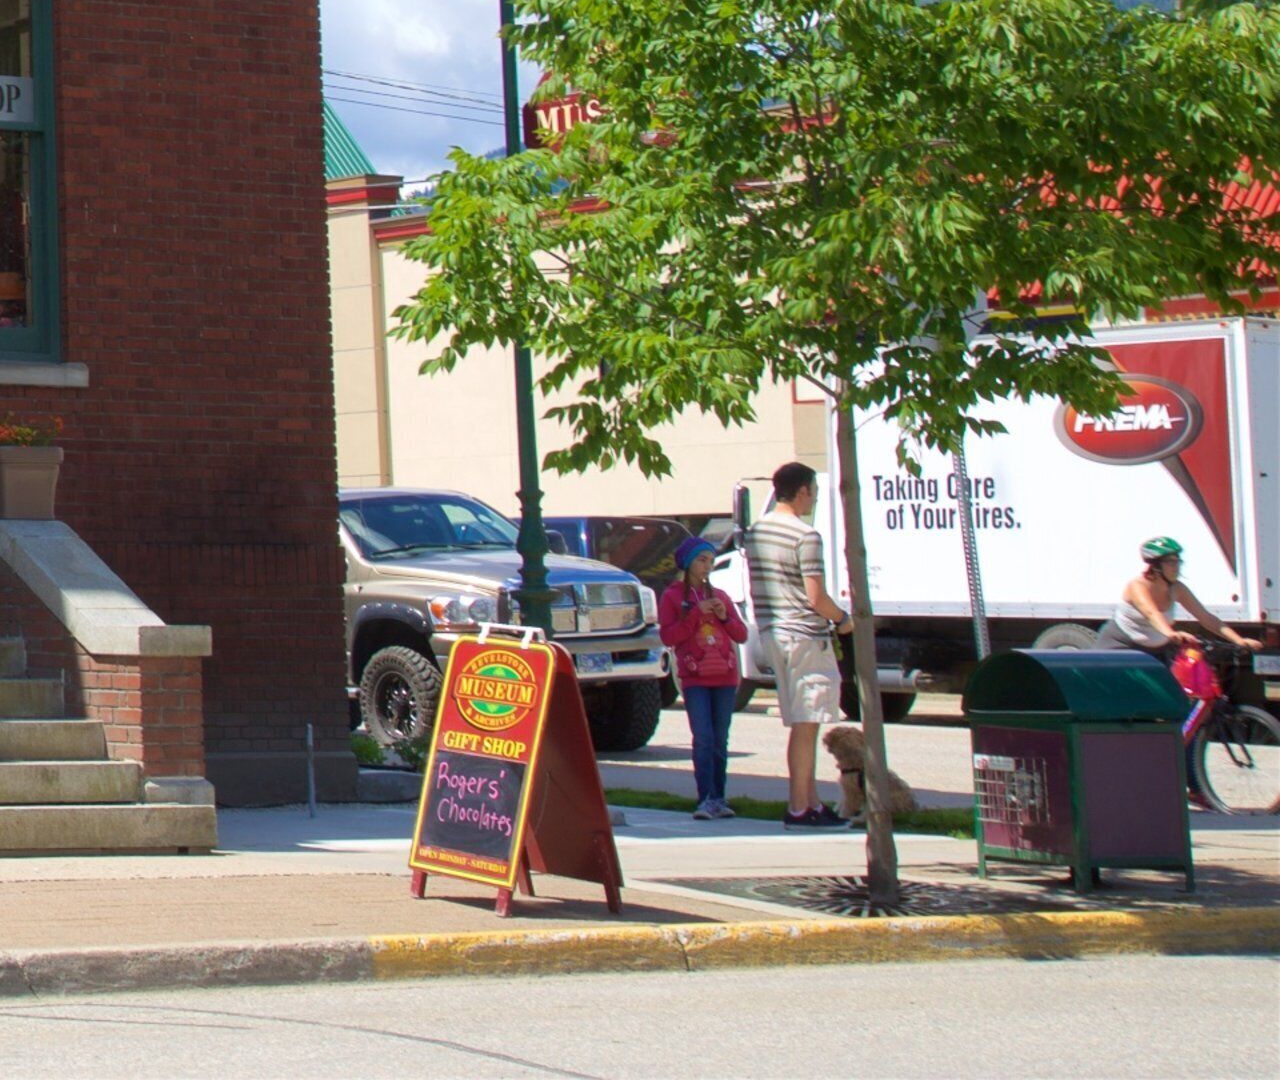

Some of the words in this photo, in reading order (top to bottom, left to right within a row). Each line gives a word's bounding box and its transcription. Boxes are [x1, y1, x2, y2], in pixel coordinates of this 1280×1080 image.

[873, 473, 938, 503] Taking
[886, 504, 904, 530] of
[911, 503, 956, 530] Your
[970, 502, 1021, 530] ires.
[458, 677, 534, 703] MUSEUM
[443, 730, 481, 751] GIFT
[482, 736, 526, 758] SHOP
[437, 761, 506, 799] Rogers'
[437, 797, 512, 836] Chocolates
